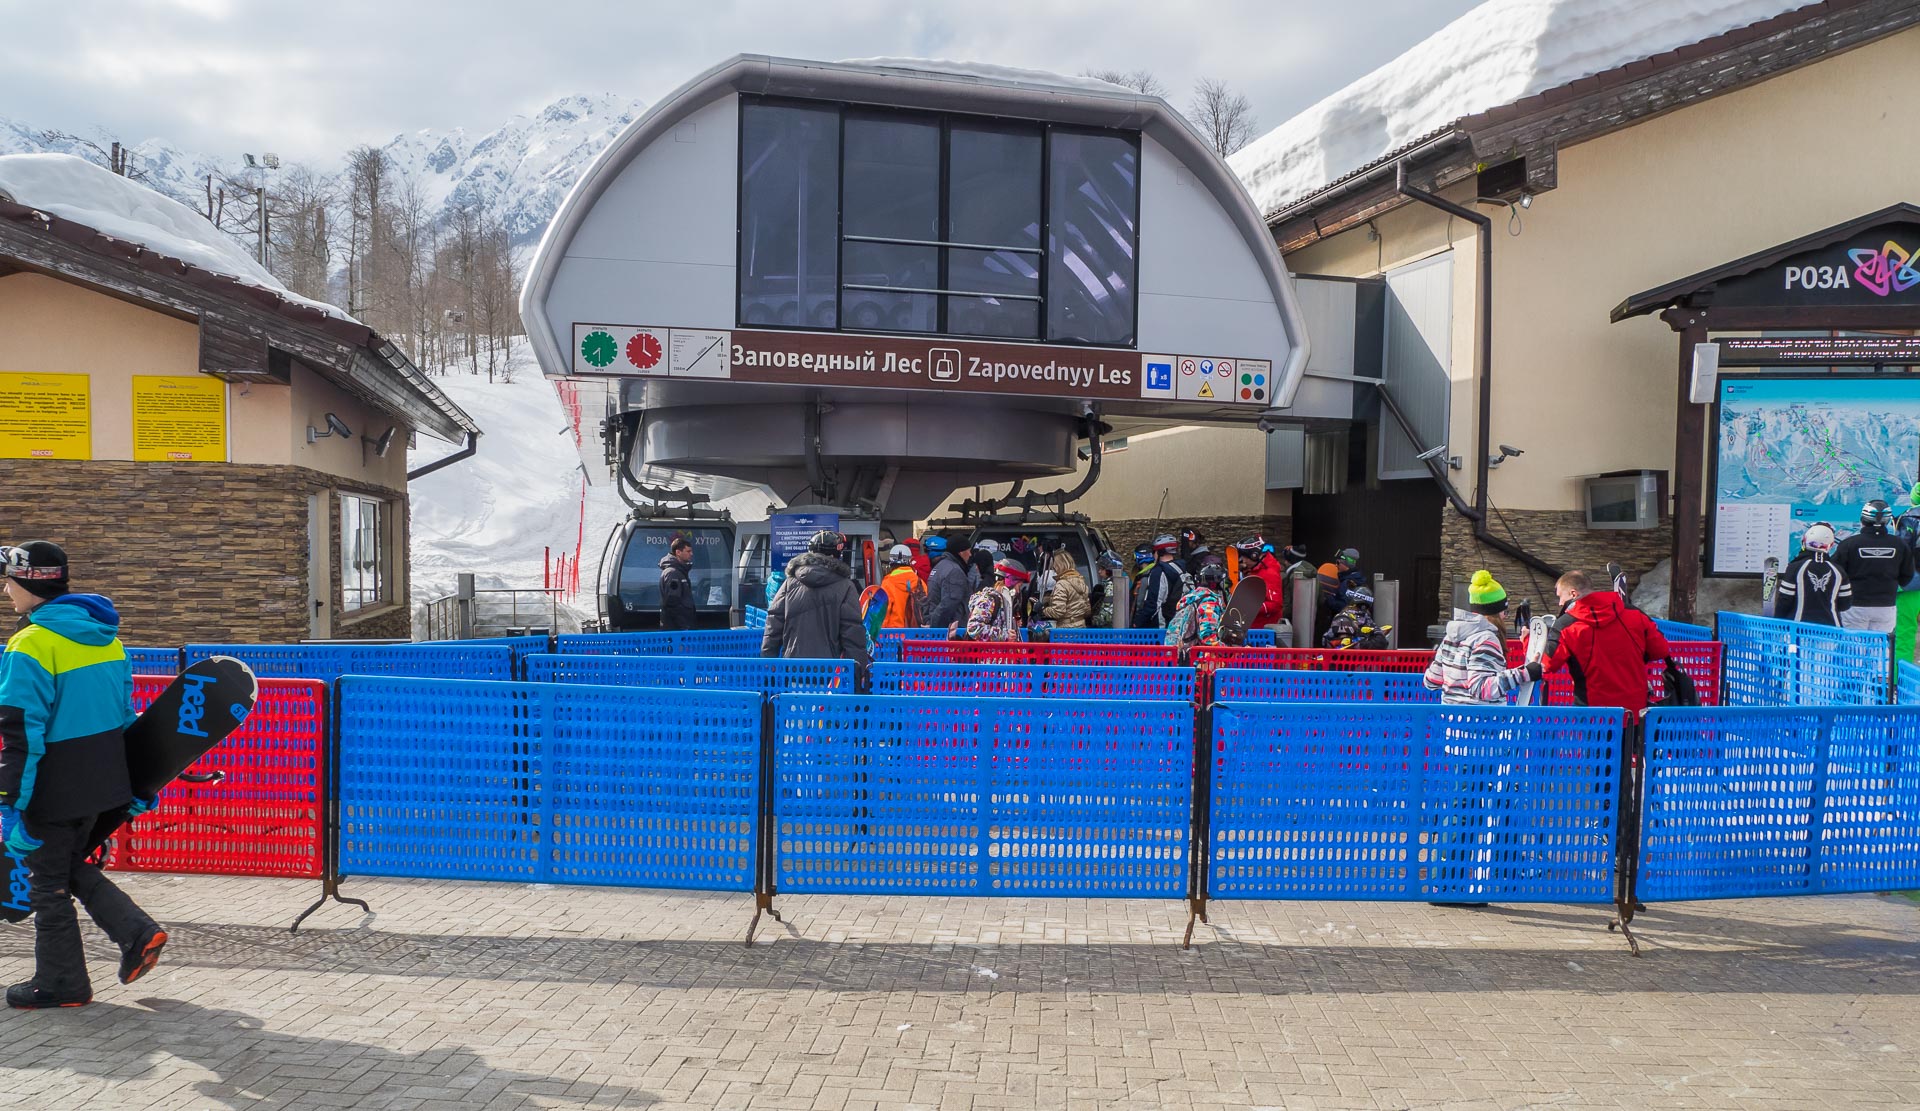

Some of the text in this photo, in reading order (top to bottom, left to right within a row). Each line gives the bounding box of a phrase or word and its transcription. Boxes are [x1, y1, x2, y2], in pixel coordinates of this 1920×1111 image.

[1785, 265, 1850, 289] РОЗА
[731, 345, 922, 374] Заповедный Лес
[968, 357, 1132, 387] Zapovednyy Les
[646, 536, 667, 544] РОЗА
[695, 537, 721, 545] ХУТОР
[625, 603, 633, 611] 45
[176, 673, 217, 738] head
[233, 707, 246, 718] 51
